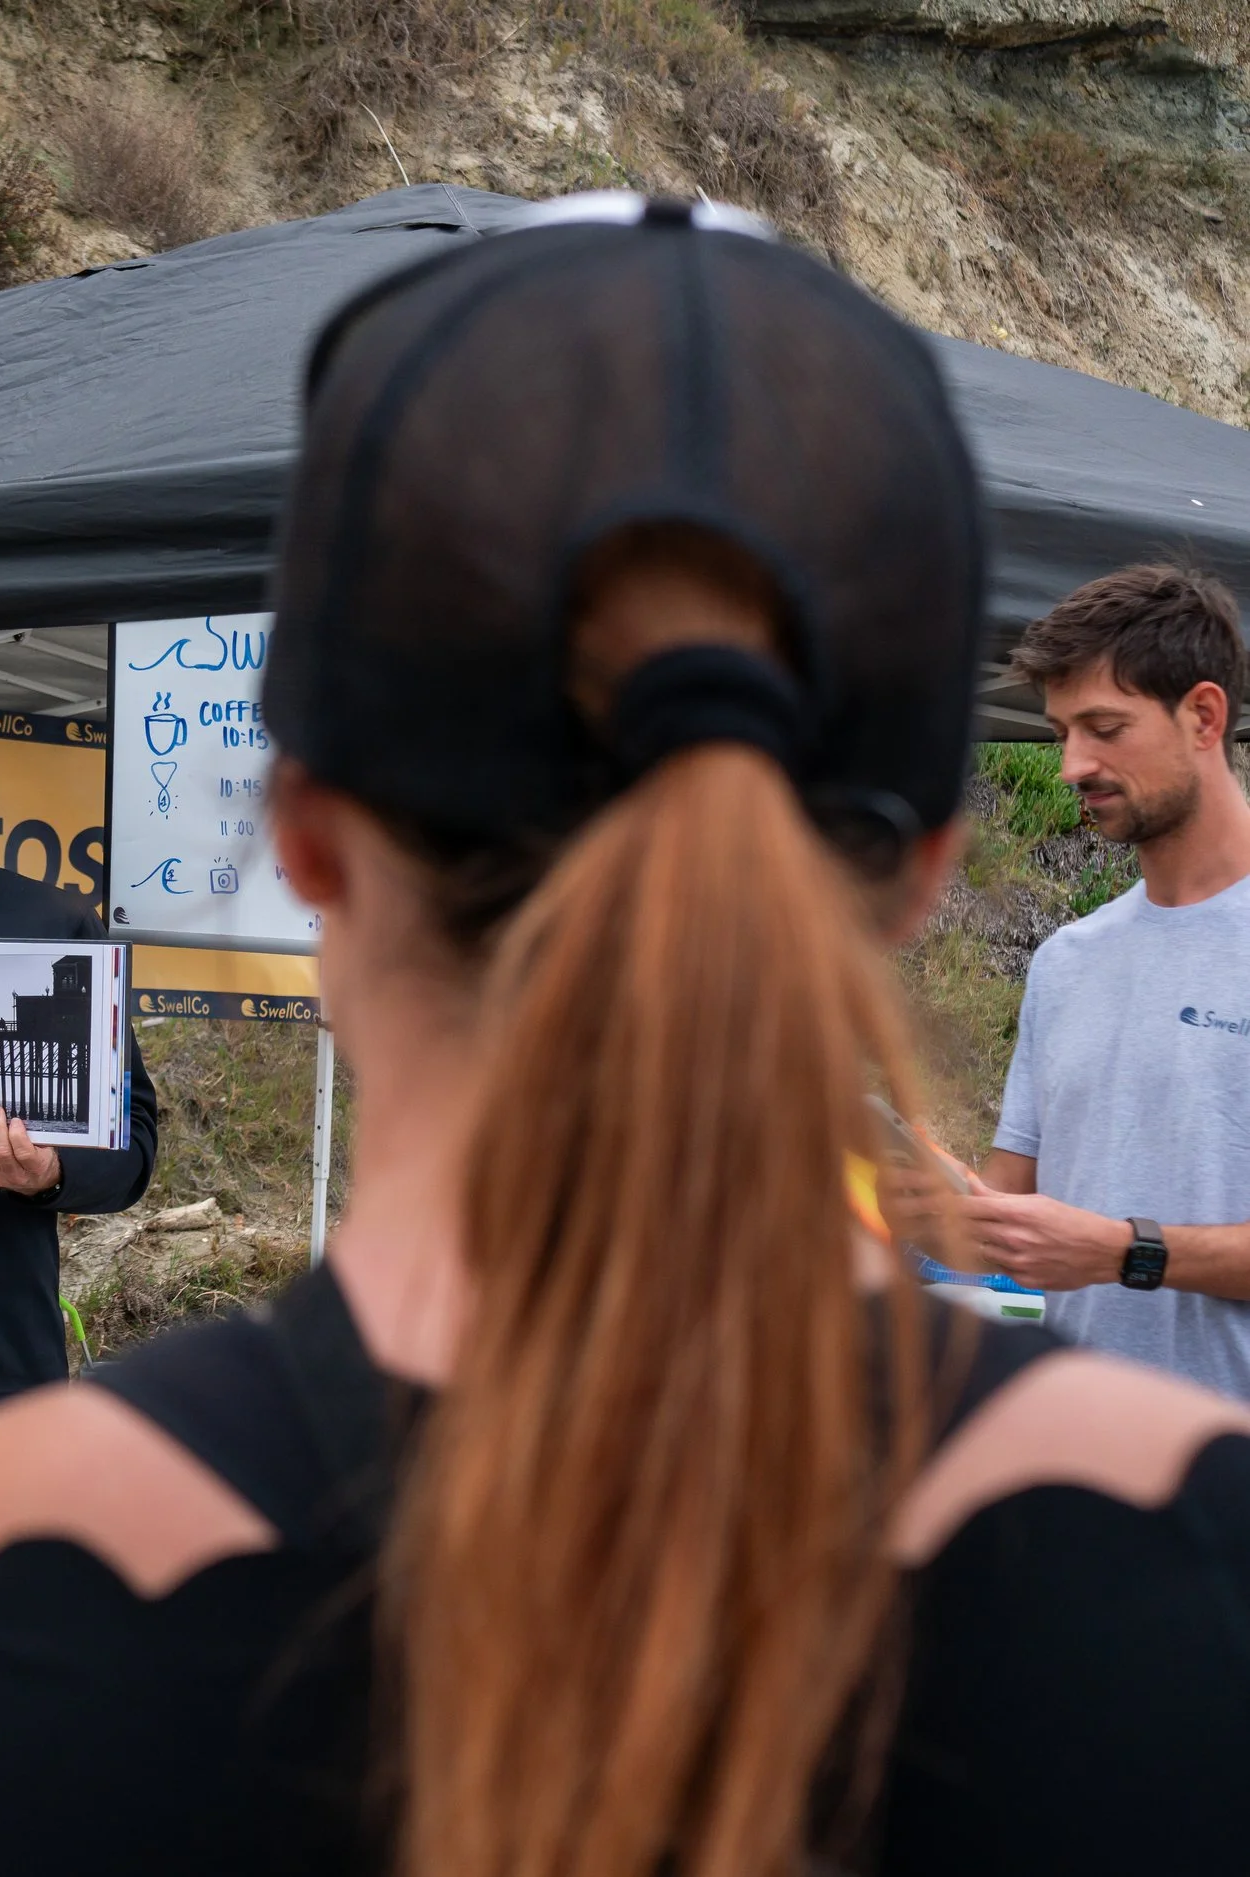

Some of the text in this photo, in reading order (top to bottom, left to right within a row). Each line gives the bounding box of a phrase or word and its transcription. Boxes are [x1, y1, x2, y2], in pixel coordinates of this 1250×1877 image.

[199, 700, 263, 726] COFFE
[223, 726, 269, 750] 10:15
[220, 777, 263, 797] 10:45
[157, 995, 210, 1015] SwellCo
[259, 1000, 311, 1020] SwellCo
